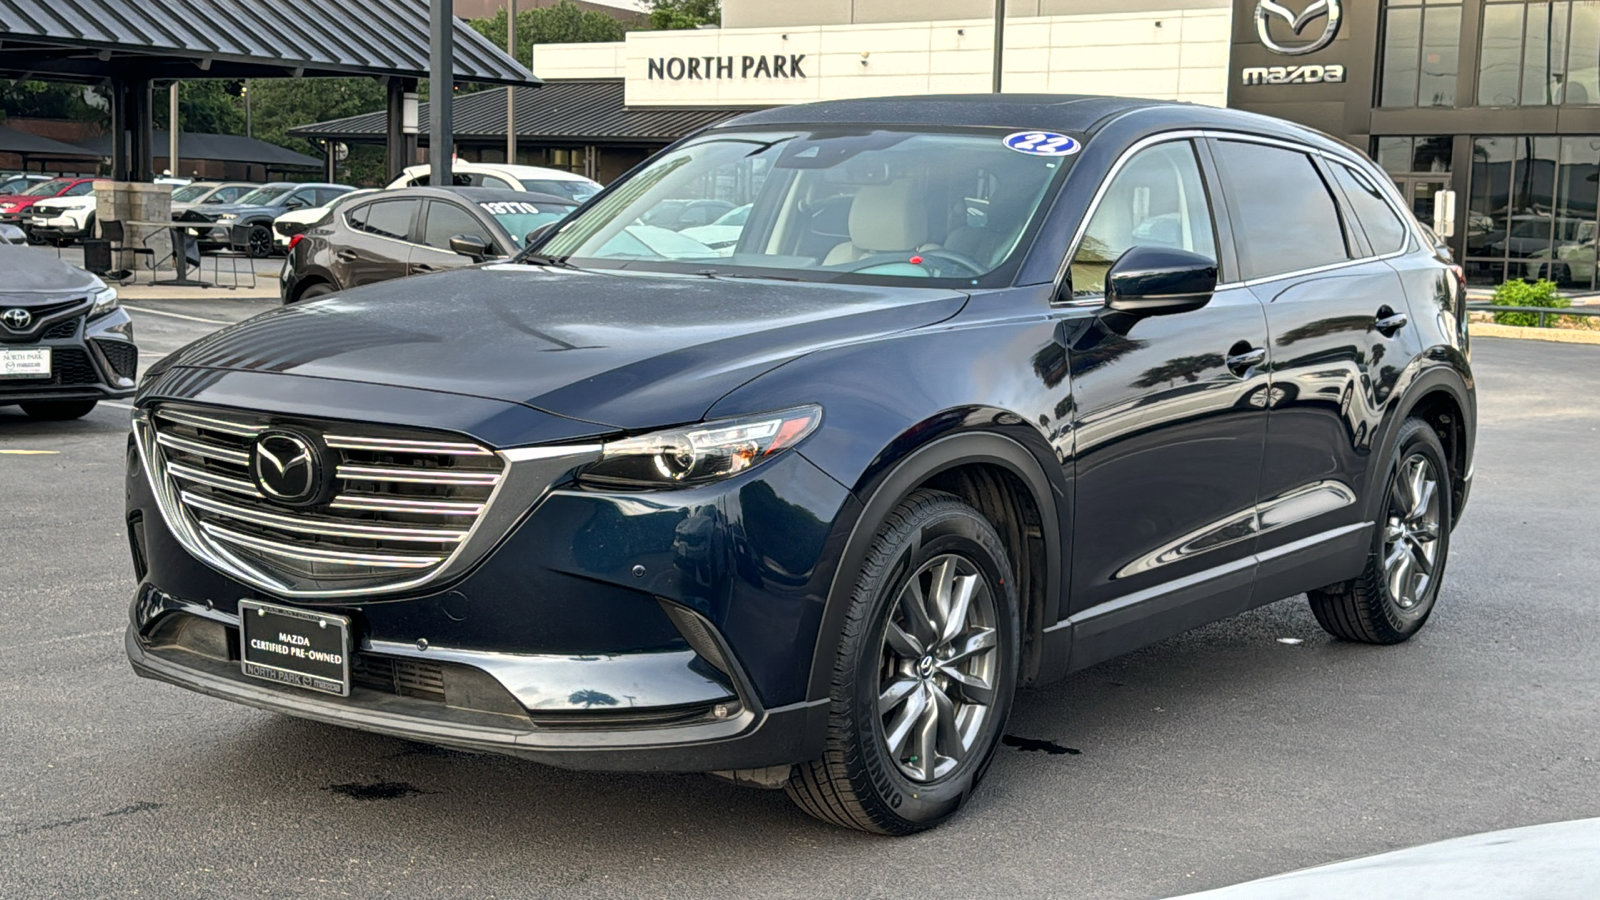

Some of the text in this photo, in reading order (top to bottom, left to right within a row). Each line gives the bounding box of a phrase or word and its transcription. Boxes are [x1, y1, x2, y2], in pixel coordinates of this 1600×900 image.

[648, 55, 807, 80] NORTH PARK
[1242, 65, 1344, 85] mazda
[1014, 134, 1069, 153] 22
[480, 202, 539, 214] 13770
[279, 633, 310, 647] MAZDA
[251, 639, 342, 664] CERTIFIED PRE-OWNED
[247, 665, 277, 679] NORTH
[278, 671, 301, 684] PARK
